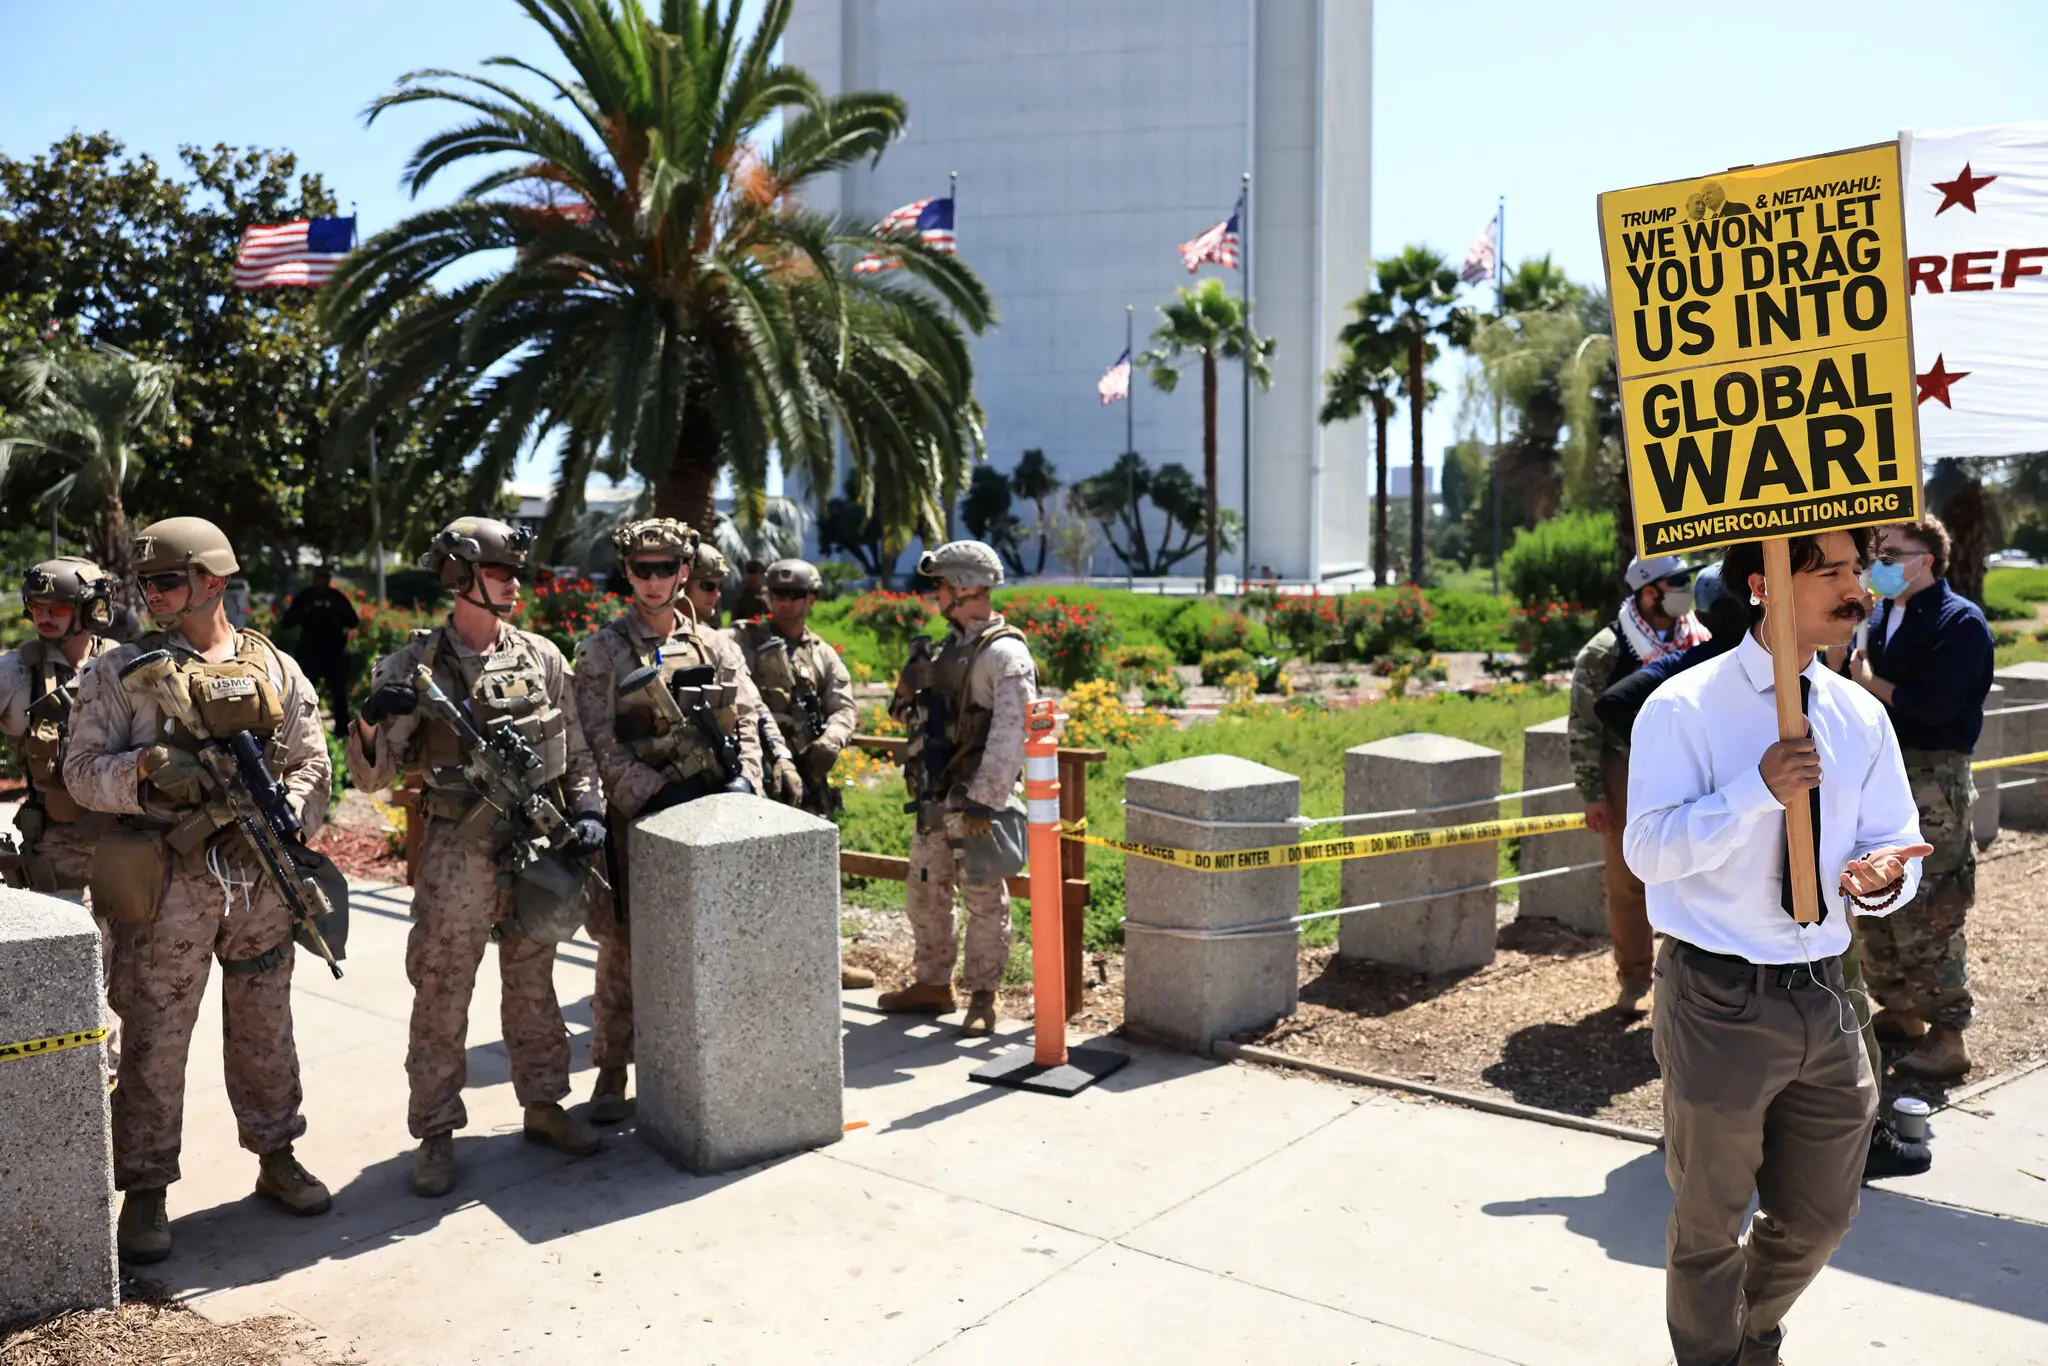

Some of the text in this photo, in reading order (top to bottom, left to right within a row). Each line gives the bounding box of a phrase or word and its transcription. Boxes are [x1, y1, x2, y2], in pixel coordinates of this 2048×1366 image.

[1755, 175, 1882, 209] & NETANYAHU:
[1621, 207, 1677, 228] TRUMP
[1622, 193, 1881, 263] WE WON'T LET
[1626, 228, 1881, 306] YOU DRAG
[1633, 274, 1887, 362] US INTO
[1642, 352, 1893, 439] GLOBAL
[1643, 407, 1899, 514] WAR!
[1655, 493, 1899, 545] ANSWERCOALITION.ORG
[212, 679, 251, 690] USMC
[1195, 851, 1270, 869] DO NOT ENTER
[1288, 842, 1355, 862] DO NOT ENTER
[1371, 832, 1431, 853] DO NOT ENTER
